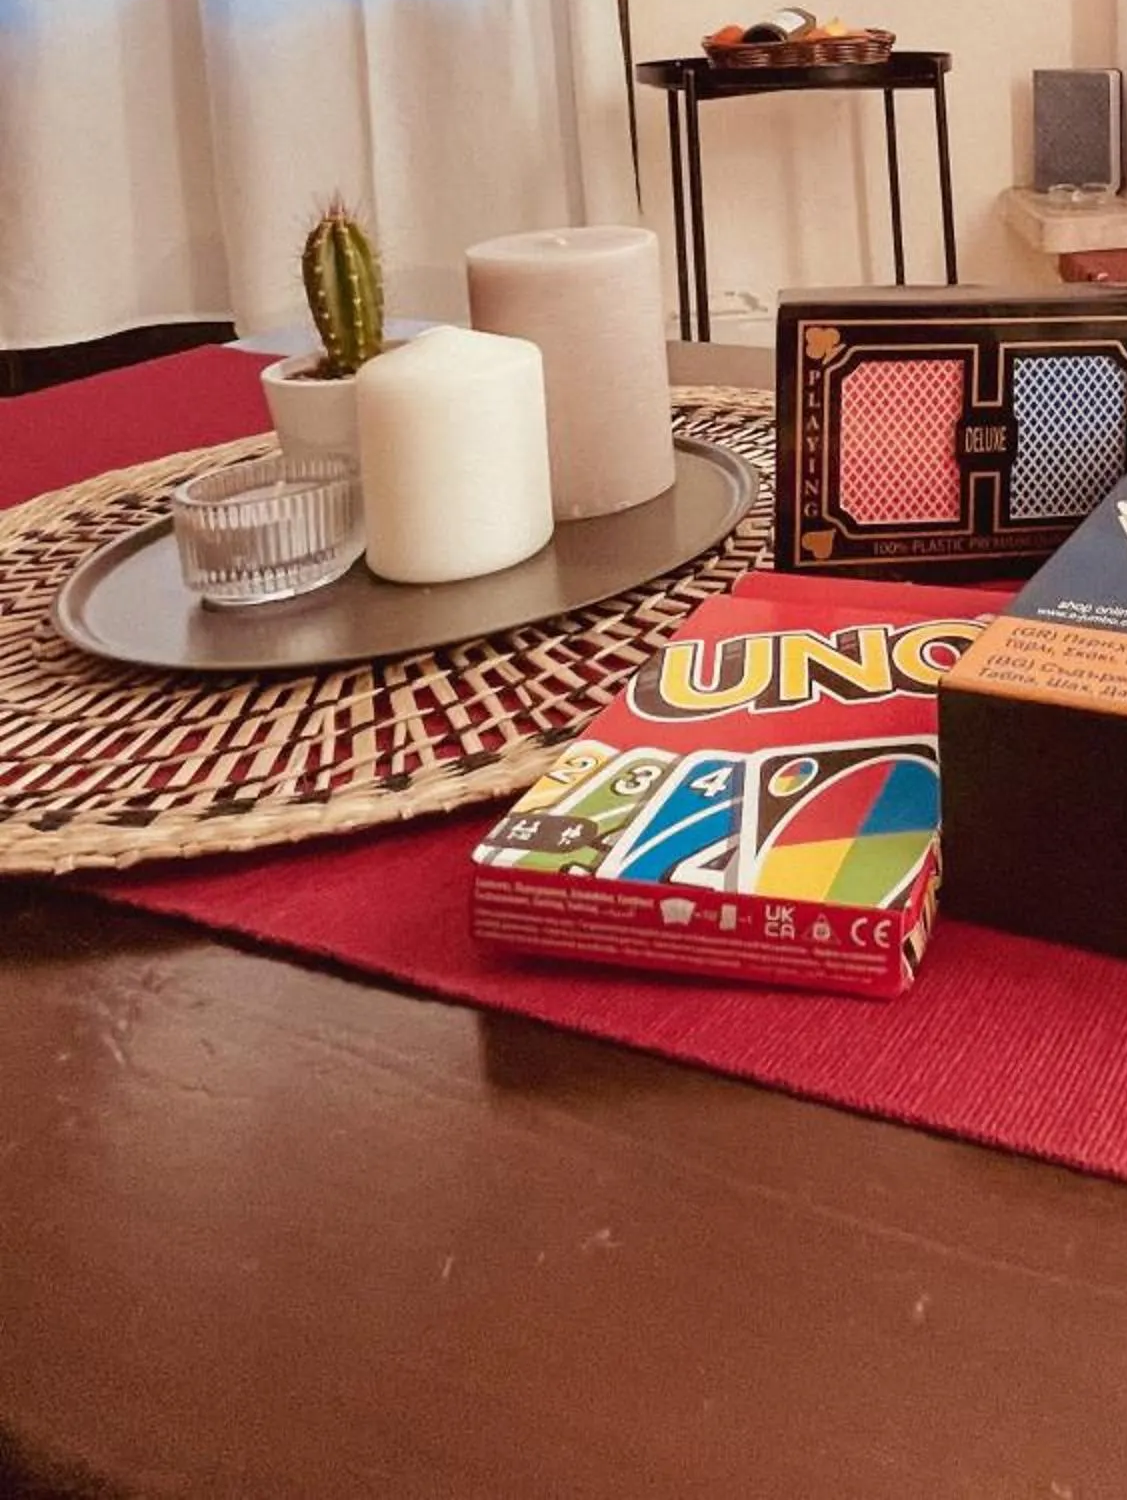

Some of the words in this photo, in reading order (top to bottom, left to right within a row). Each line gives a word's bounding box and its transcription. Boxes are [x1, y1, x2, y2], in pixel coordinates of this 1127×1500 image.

[804, 369, 822, 517] PLAYING
[965, 426, 1007, 453] DELUXE
[1057, 599, 1093, 614] shop
[627, 621, 981, 722] UNO
[549, 756, 599, 785] 2
[610, 764, 664, 796] 3
[689, 766, 734, 797] 4
[765, 905, 797, 922] UK
[764, 923, 796, 940] CA
[851, 917, 892, 948] CE
